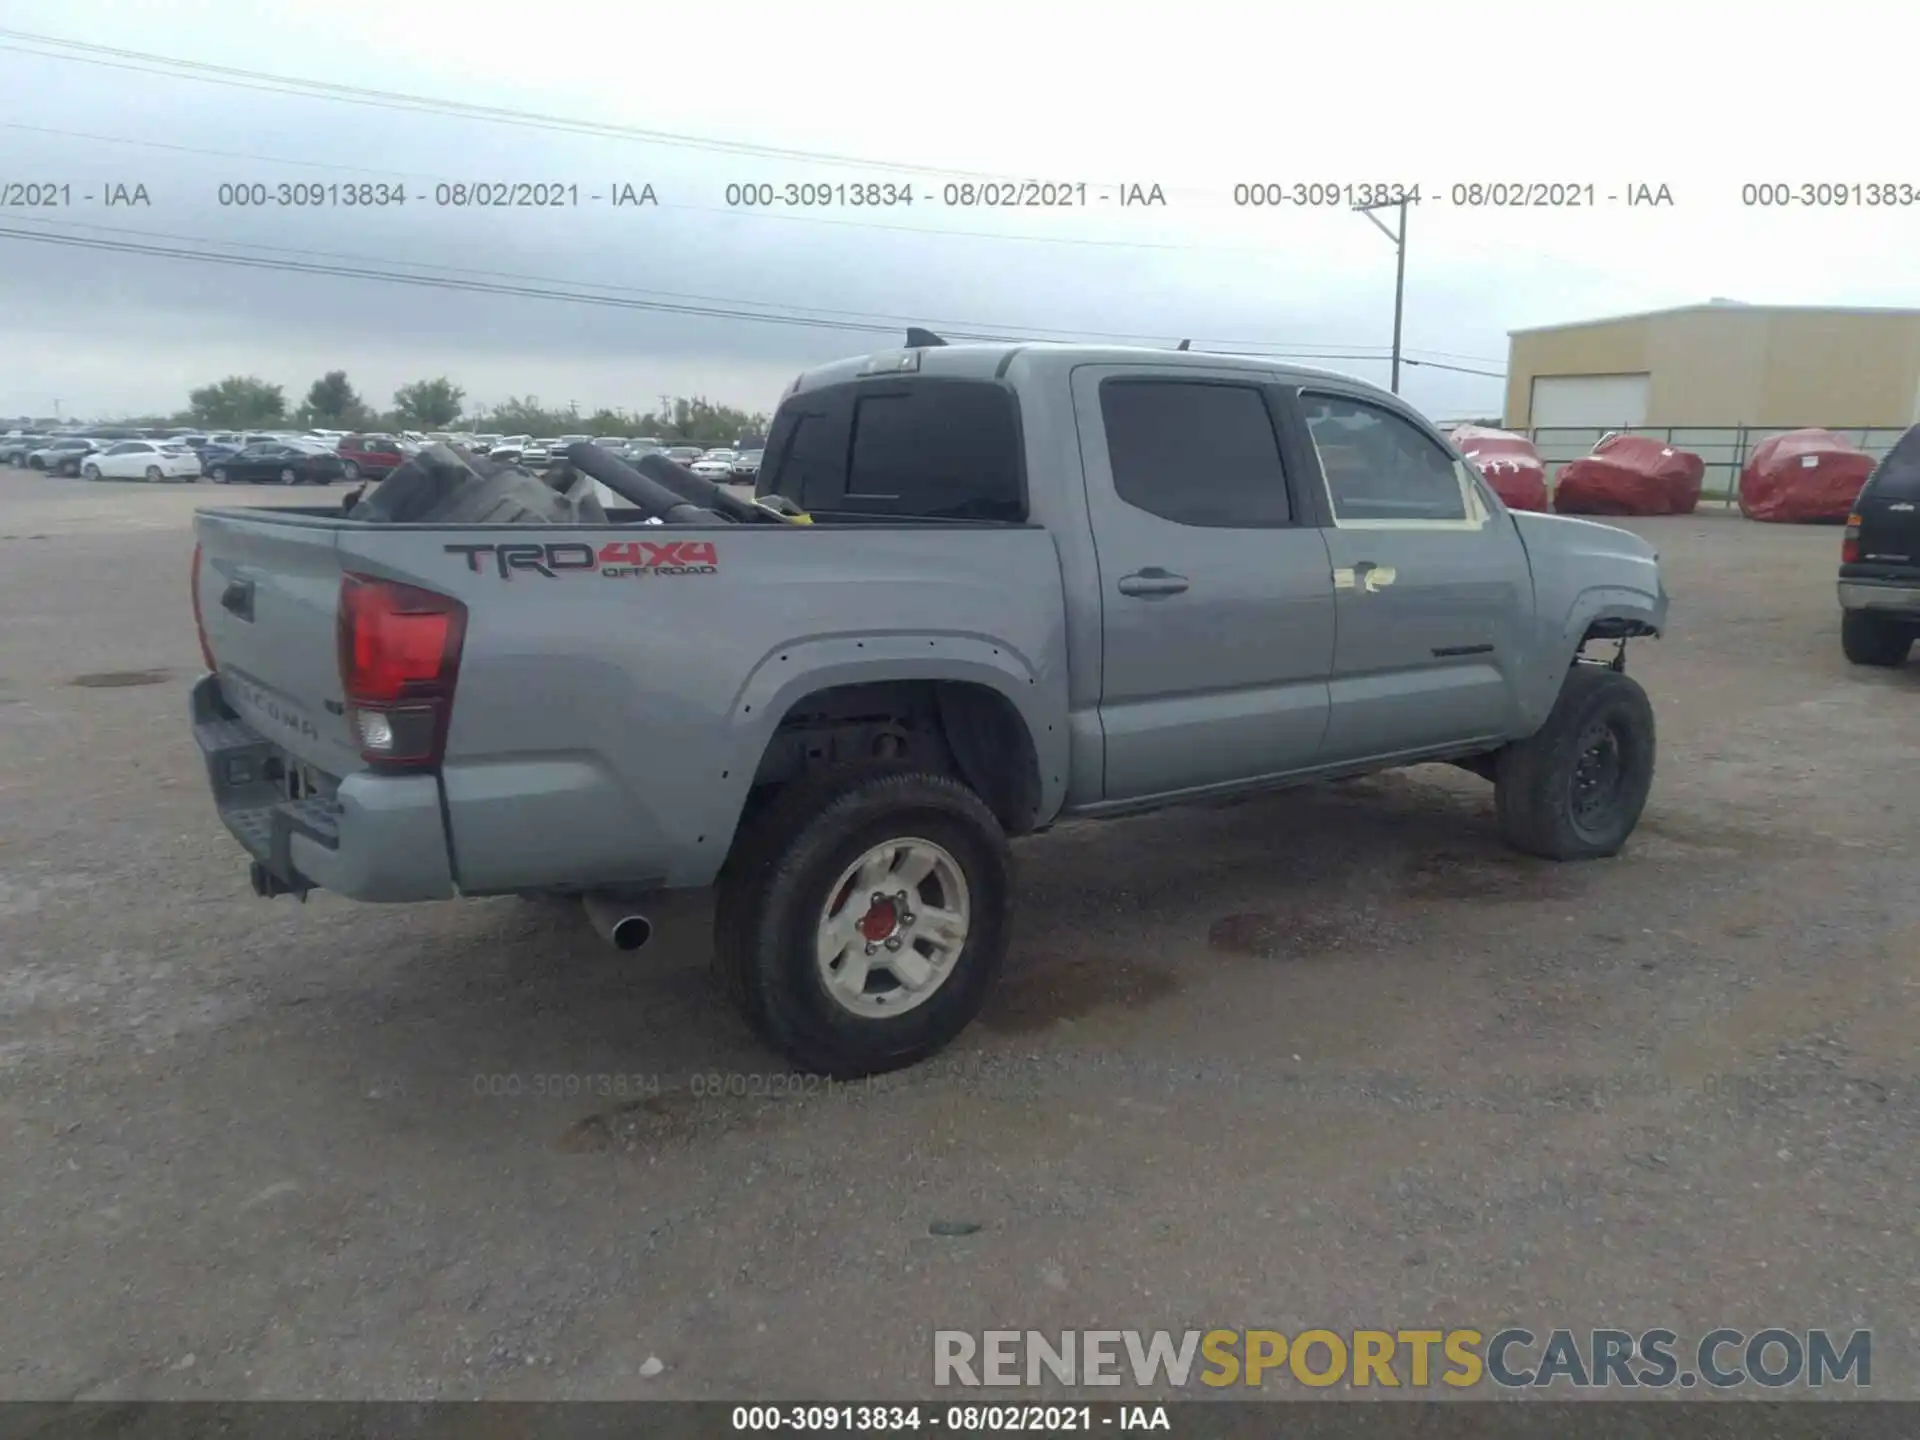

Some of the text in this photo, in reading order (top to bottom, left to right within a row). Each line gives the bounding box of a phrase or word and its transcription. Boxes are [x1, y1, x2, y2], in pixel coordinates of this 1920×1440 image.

[444, 543, 593, 579] TRD
[602, 564, 718, 578] OFF ROAD
